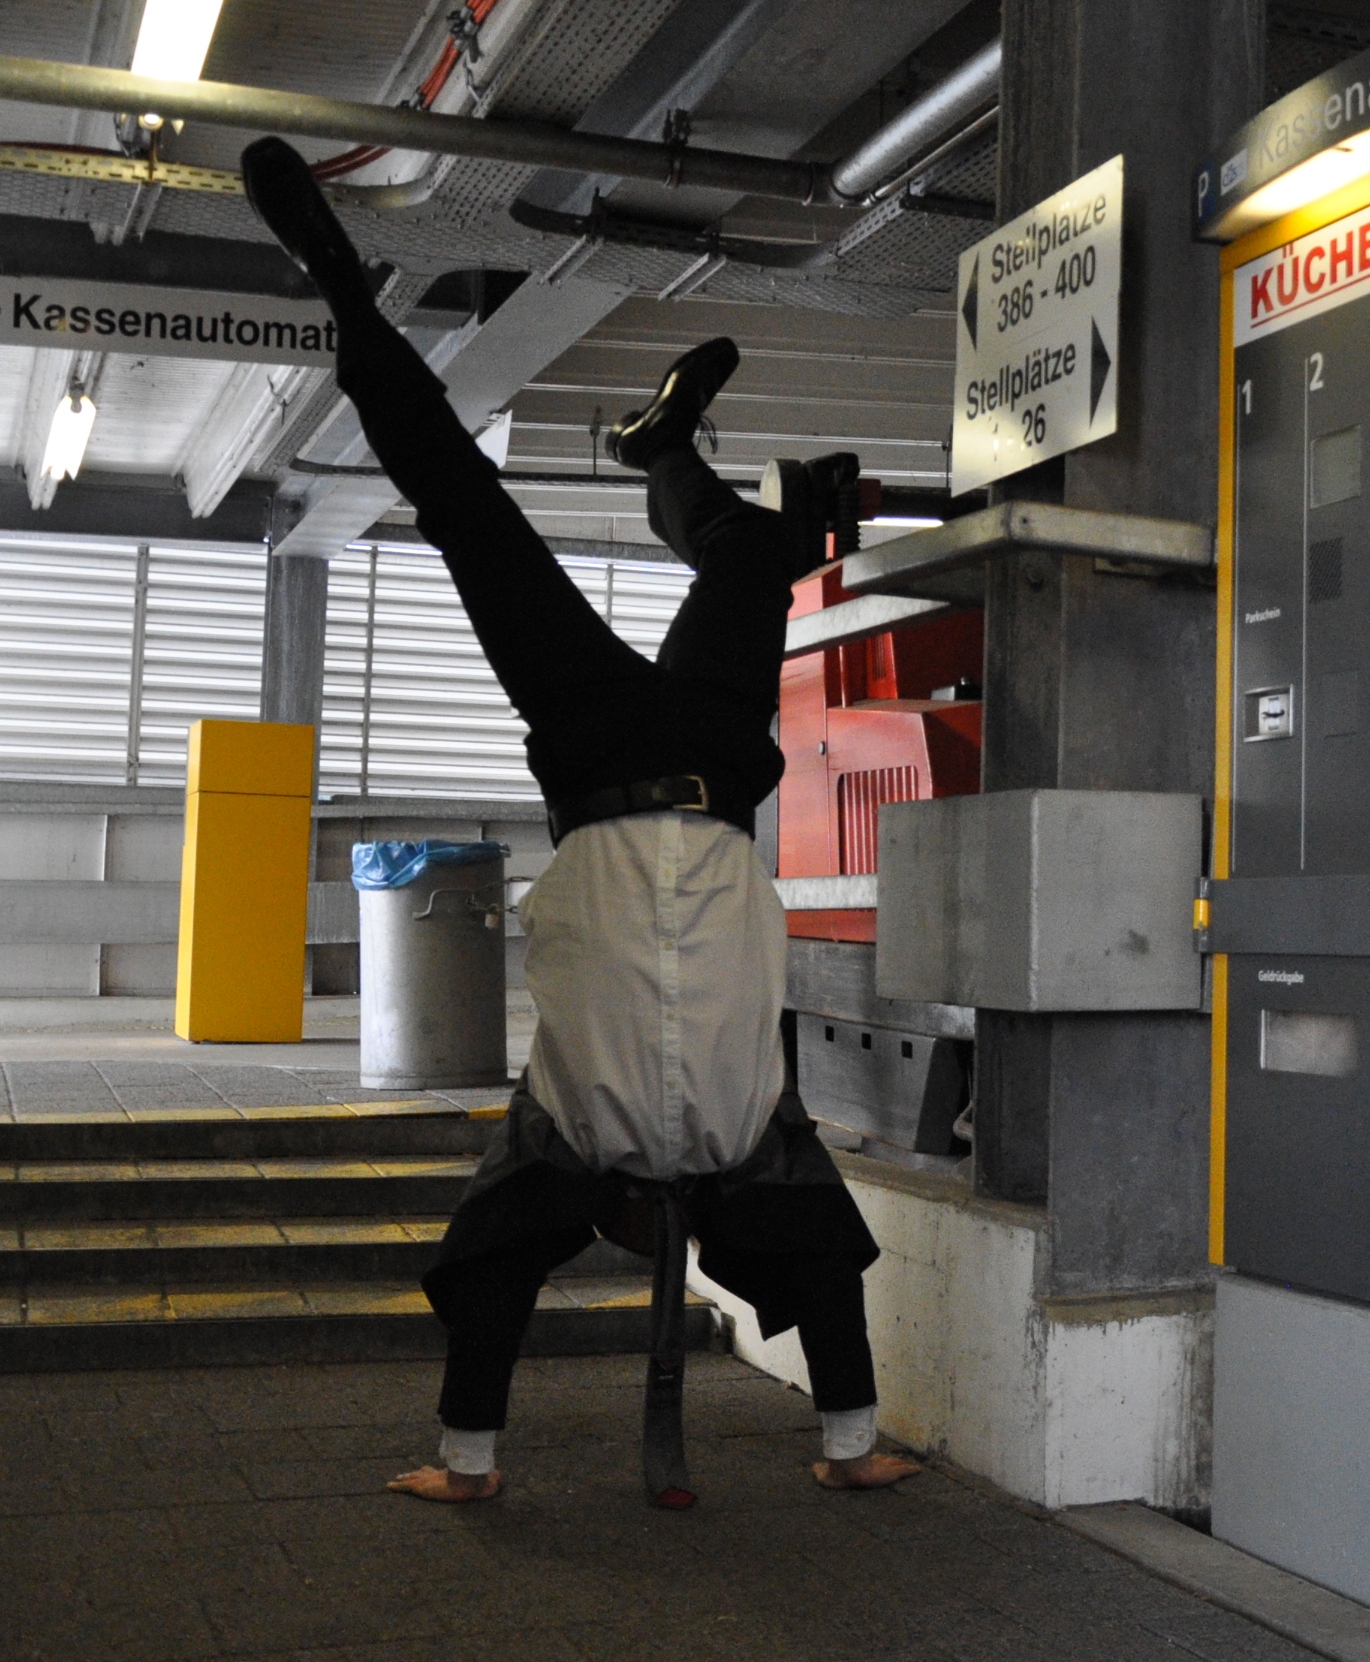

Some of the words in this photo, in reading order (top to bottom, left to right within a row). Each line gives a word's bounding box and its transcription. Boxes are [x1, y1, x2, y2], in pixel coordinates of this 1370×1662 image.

[997, 278, 1033, 334] 386
[1055, 244, 1096, 300] 400
[13, 292, 337, 352] Kassenautomat
[966, 342, 1076, 421] Stellplätze
[1309, 352, 1324, 391] 2
[1242, 379, 1252, 415] 1
[1022, 402, 1046, 448] 26
[1245, 606, 1281, 624] Parkschein
